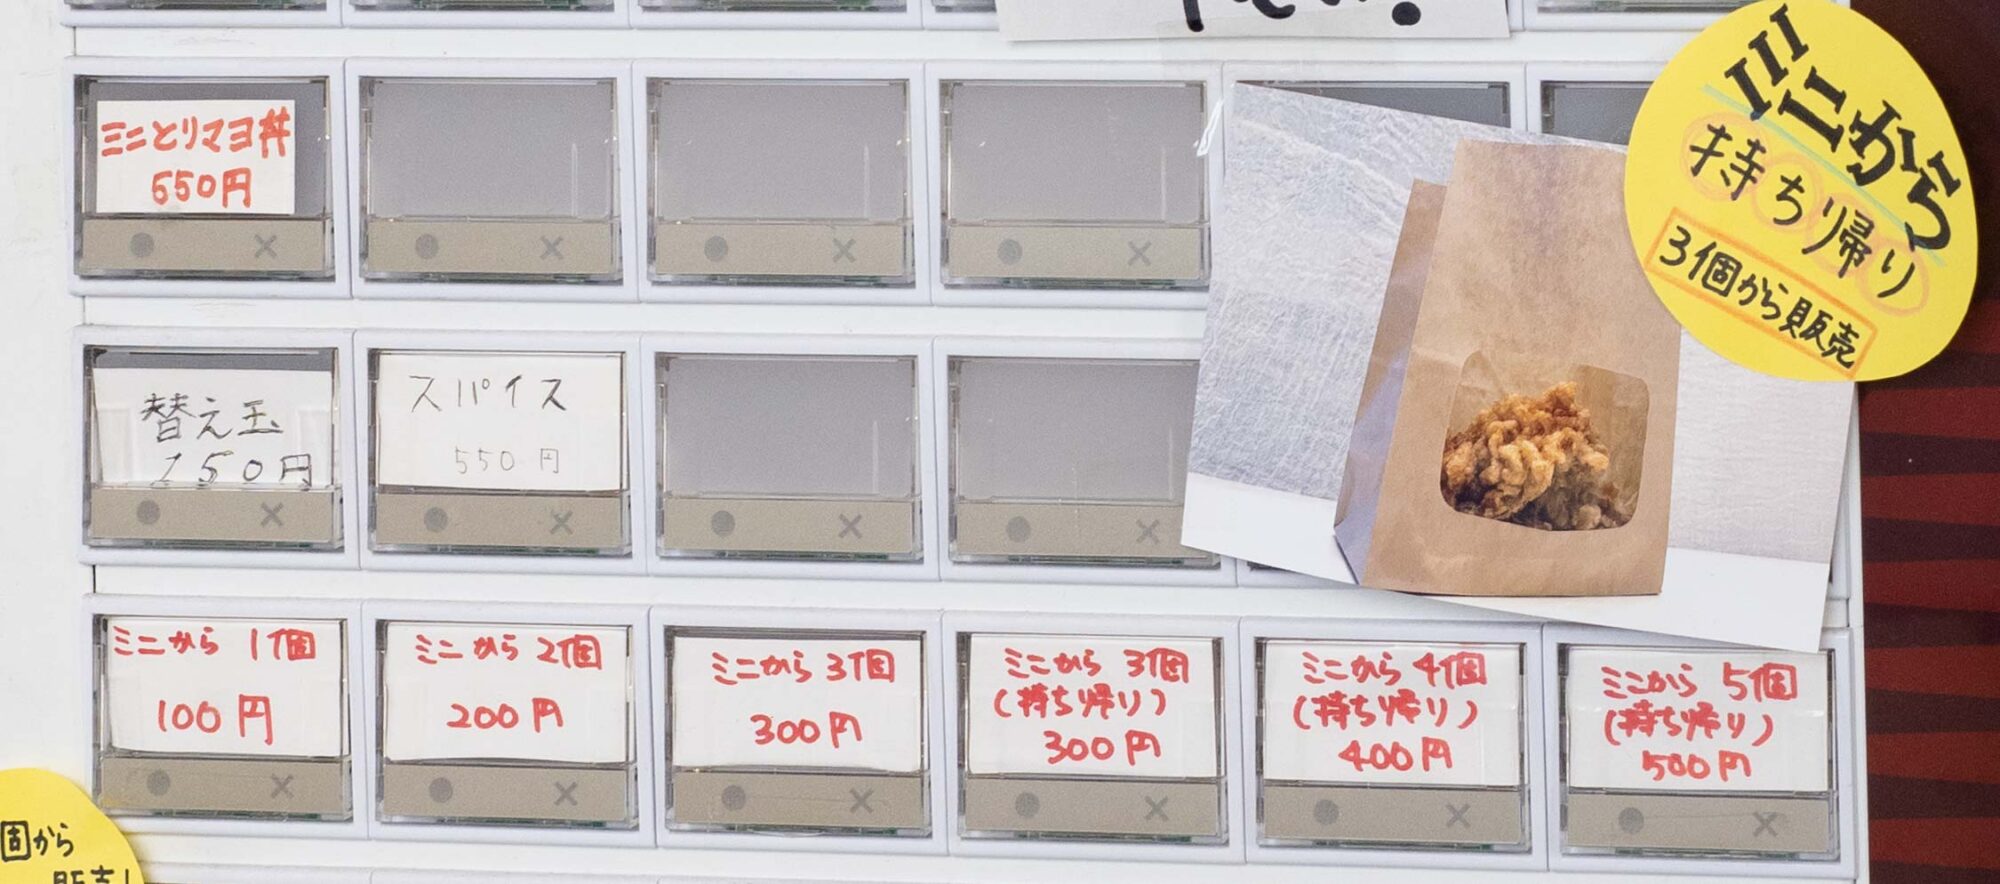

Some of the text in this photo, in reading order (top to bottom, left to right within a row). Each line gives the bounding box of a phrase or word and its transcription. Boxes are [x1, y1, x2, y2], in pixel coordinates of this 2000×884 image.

[152, 167, 251, 207] 550円
[1659, 225, 1860, 369] 3個から販売
[408, 373, 568, 413] スパイス
[140, 392, 283, 443] 替え玉
[151, 448, 314, 488] 150円
[453, 446, 561, 475] 550円
[158, 694, 273, 745] 100円
[448, 698, 563, 732] 200円
[751, 712, 861, 748] 300円
[1044, 730, 1161, 766] 300円
[1339, 736, 1453, 771] 400円
[1642, 750, 1752, 781] 500円
